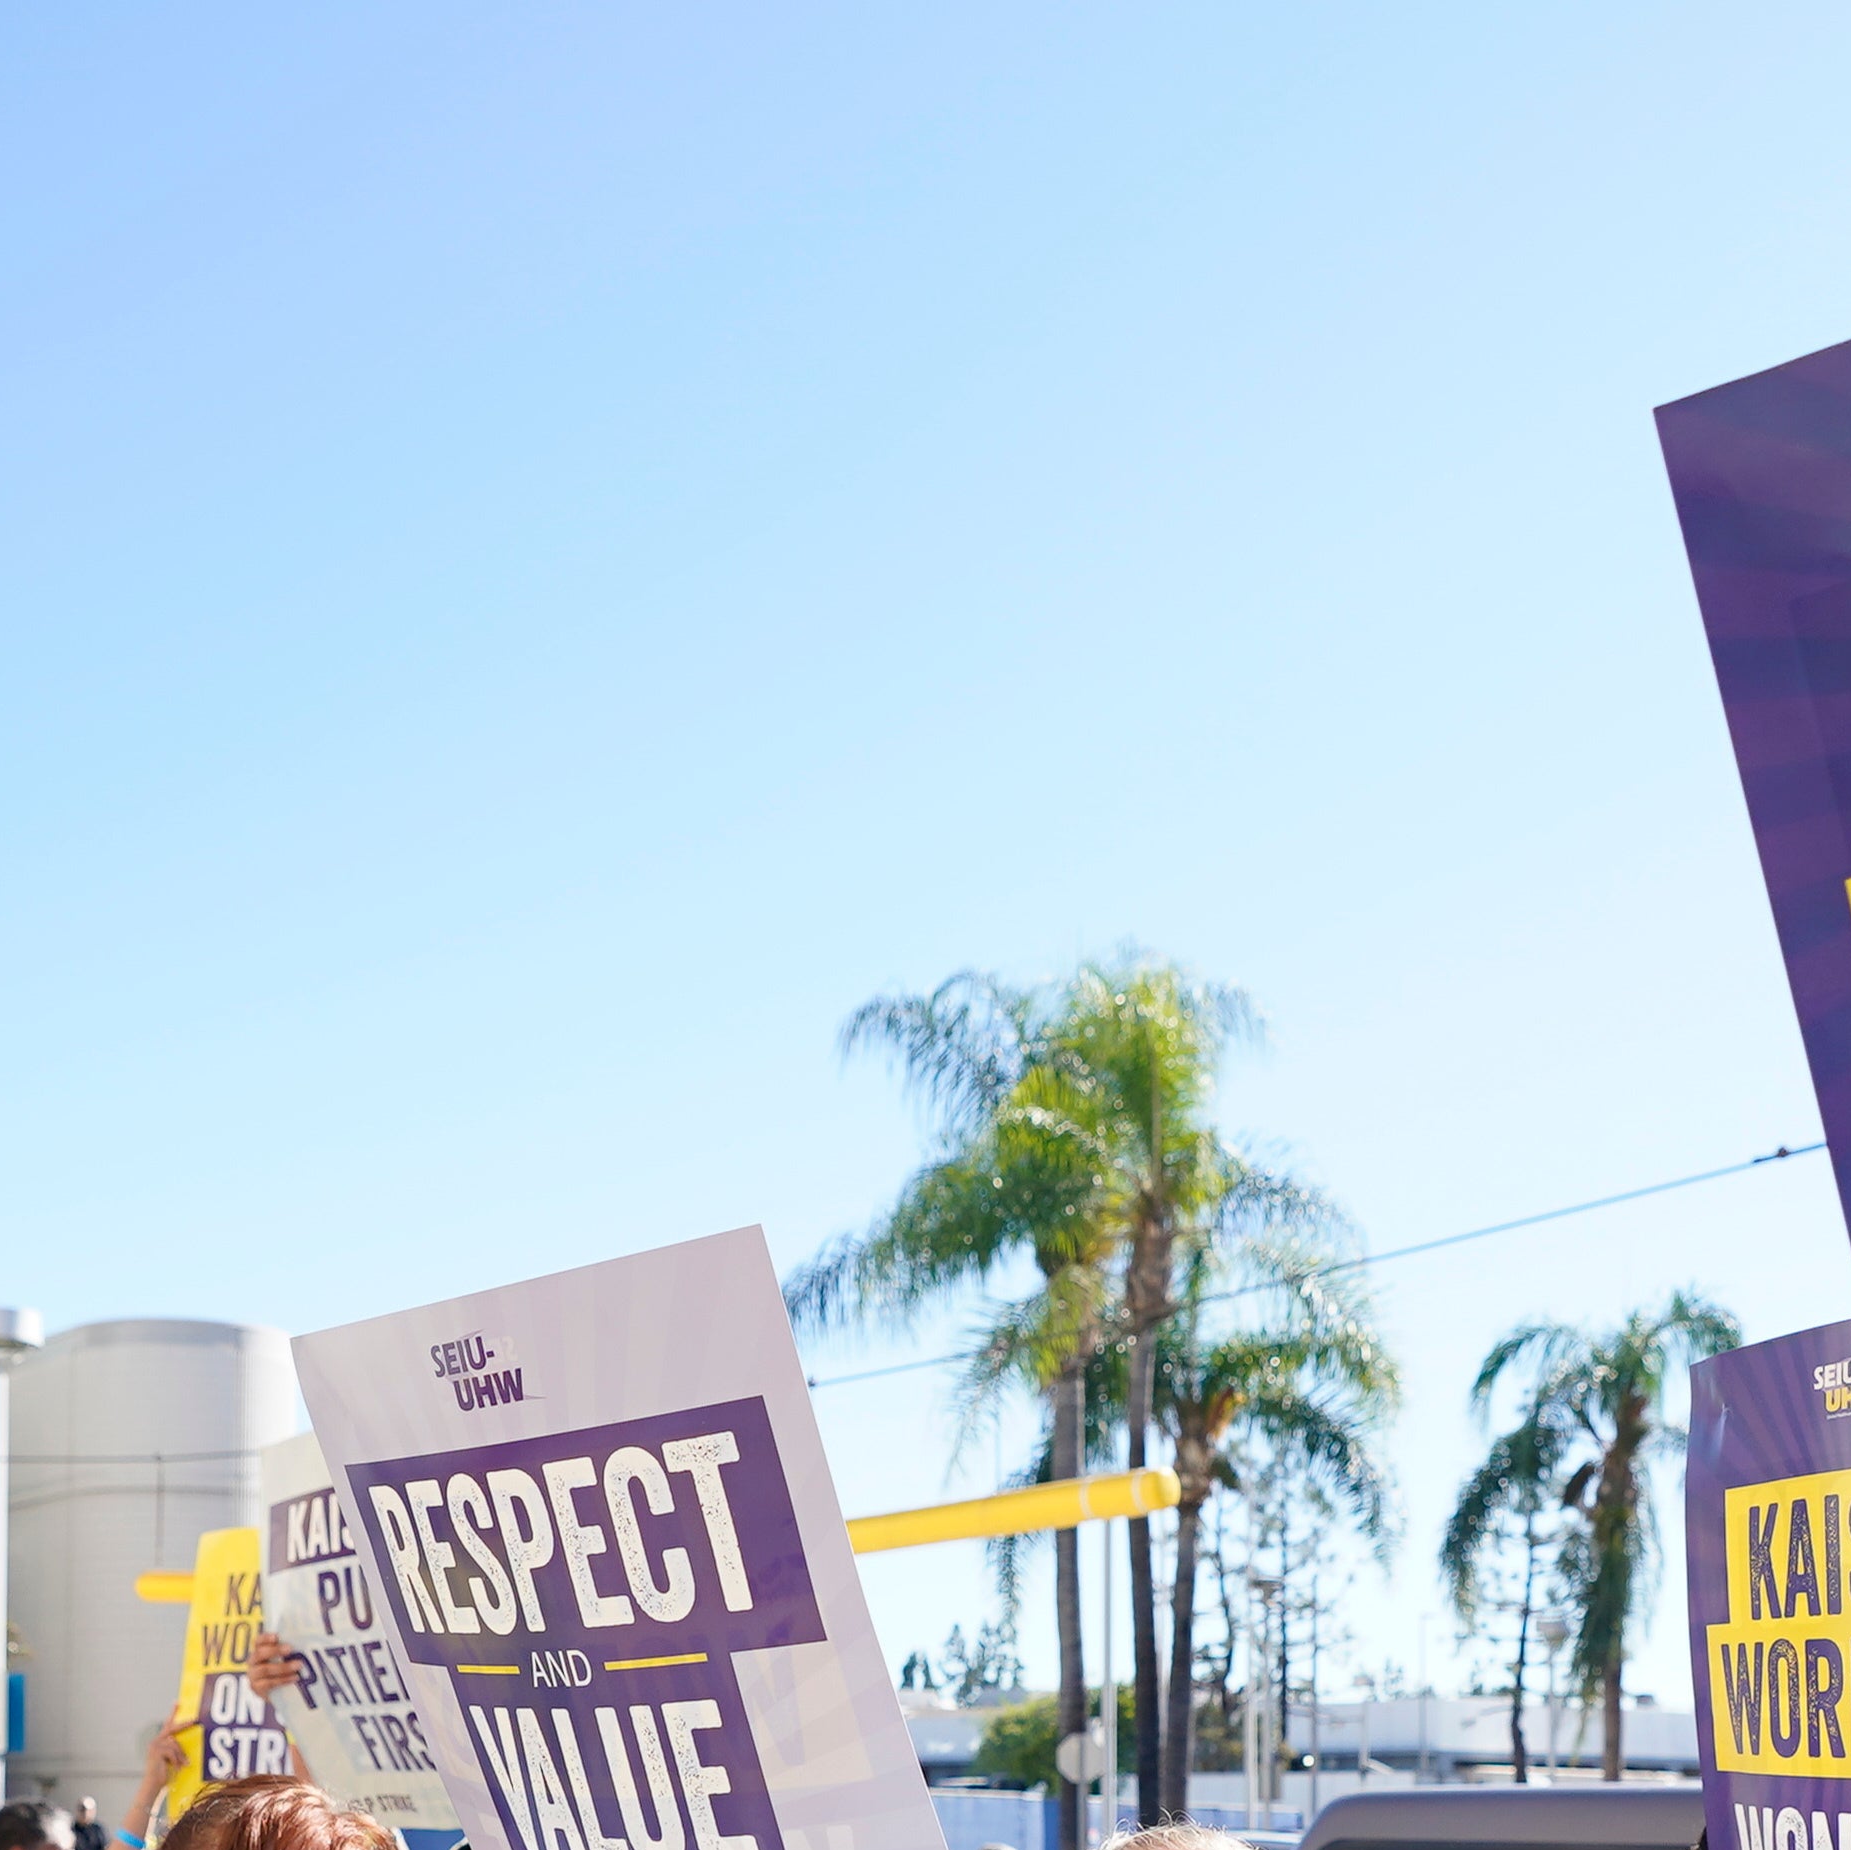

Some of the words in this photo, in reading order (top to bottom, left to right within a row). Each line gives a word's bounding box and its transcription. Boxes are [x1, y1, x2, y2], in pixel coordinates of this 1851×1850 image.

[430, 1335, 495, 1378] SEIU-
[453, 1367, 524, 1412] UHW
[367, 1430, 757, 1639] RESPECT
[530, 1647, 593, 1690] AND
